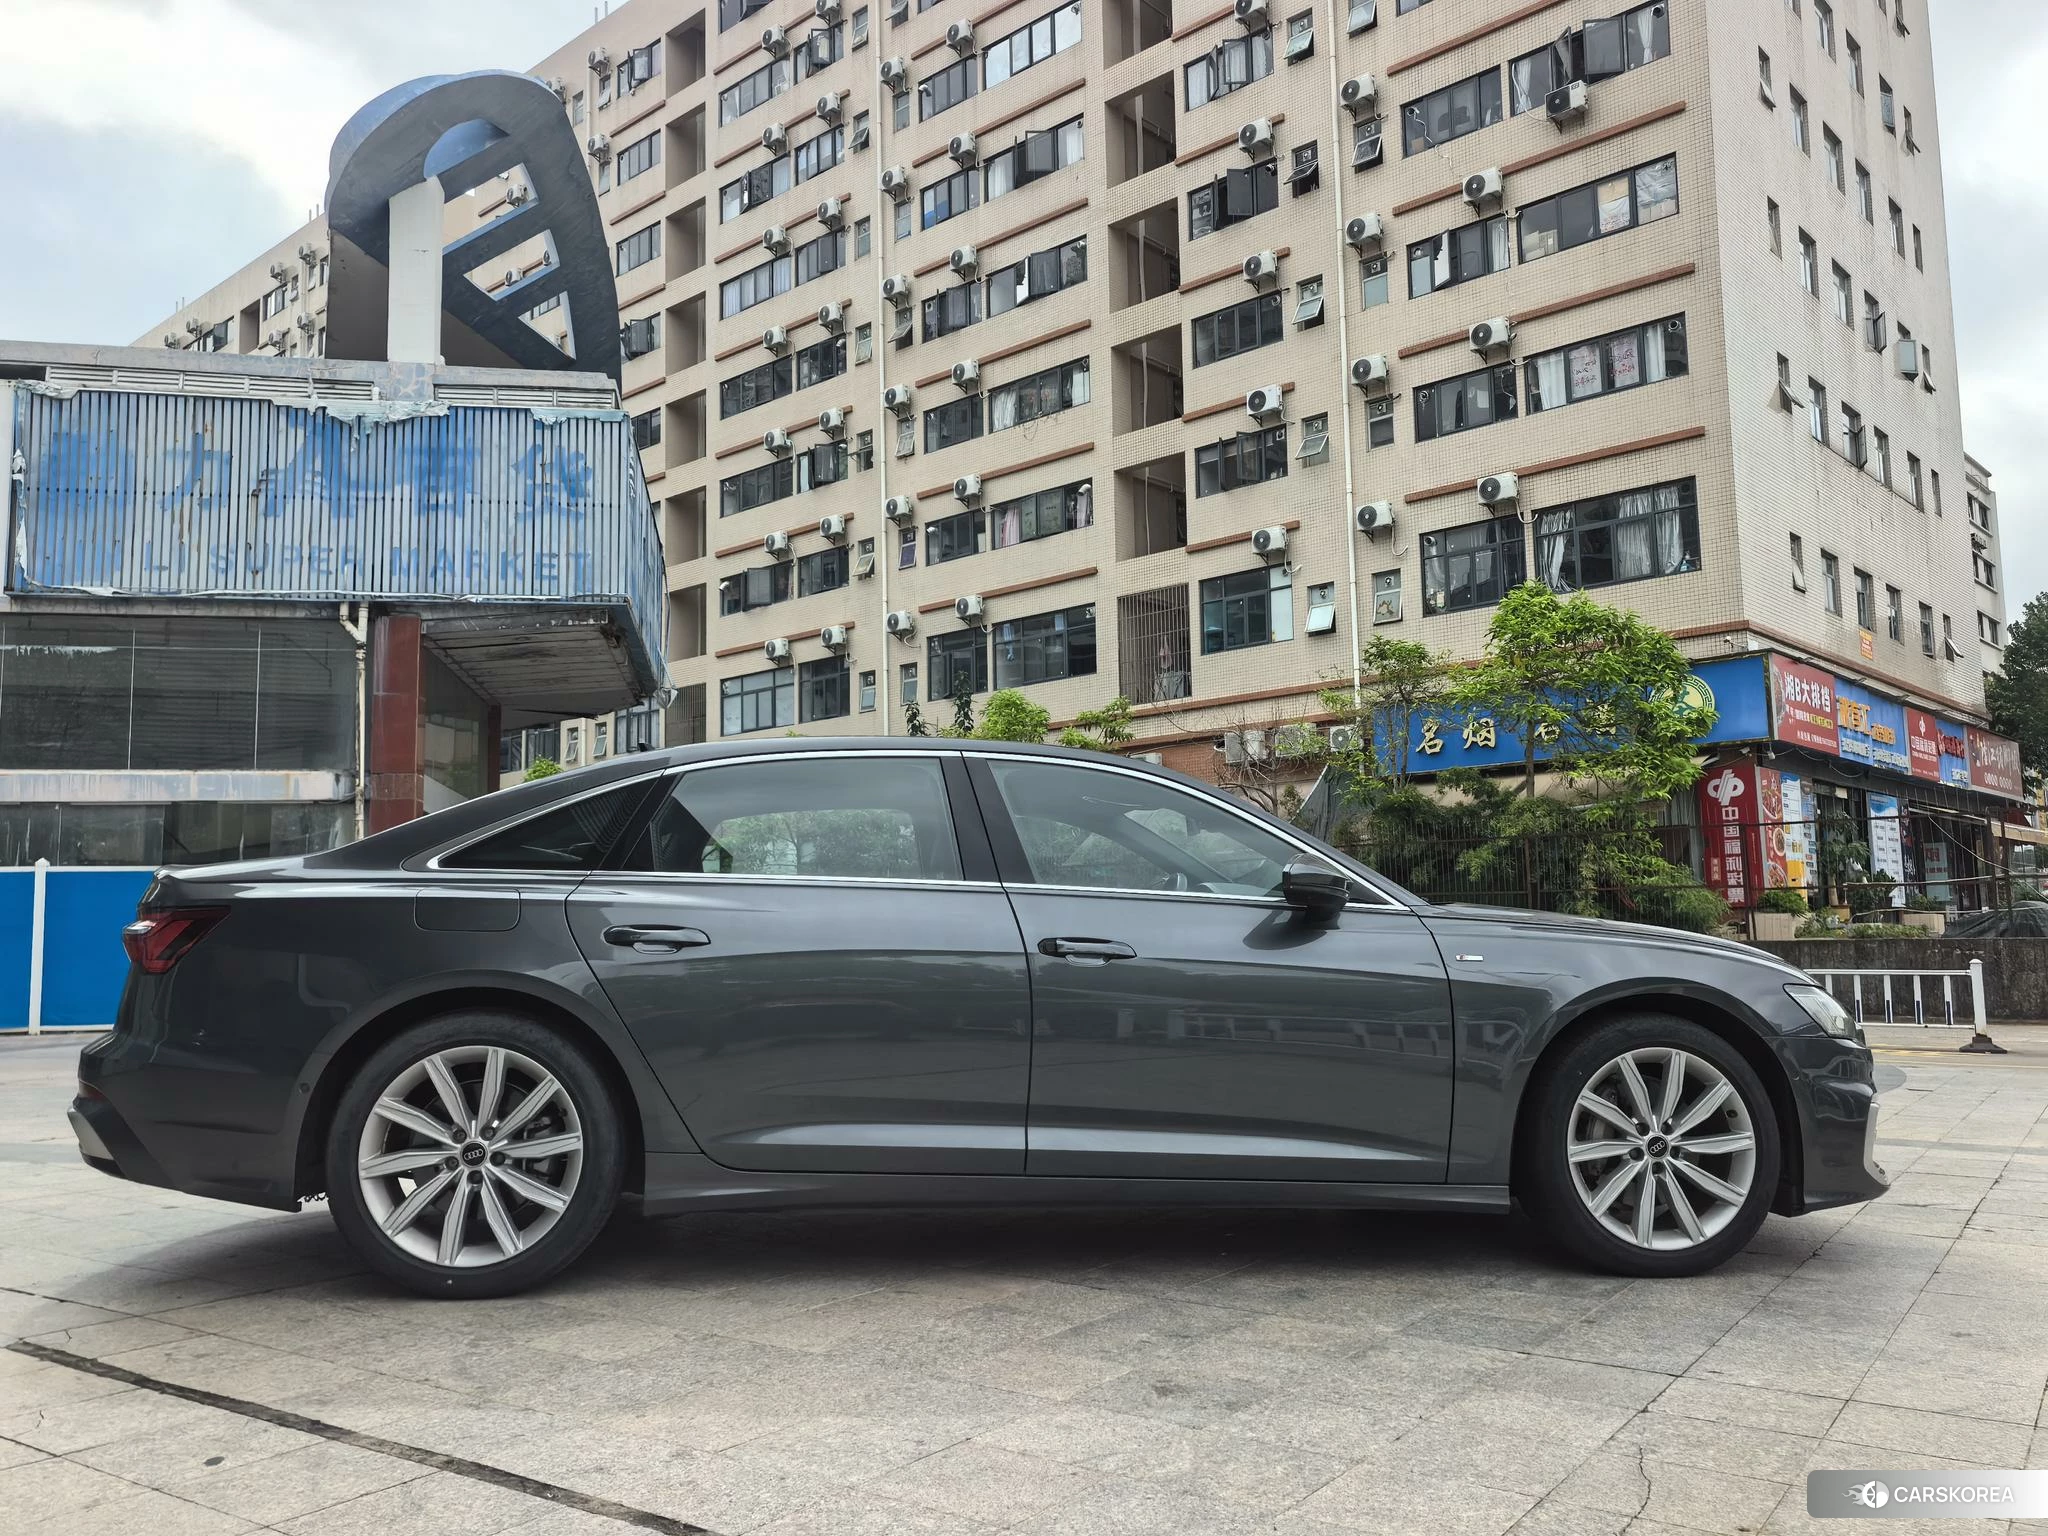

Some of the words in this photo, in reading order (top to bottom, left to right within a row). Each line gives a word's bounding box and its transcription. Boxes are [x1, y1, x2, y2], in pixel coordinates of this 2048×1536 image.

[210, 542, 364, 577] SUPER
[391, 545, 591, 583] MARKET
[1721, 806, 1745, 903] 中国福利彩票
